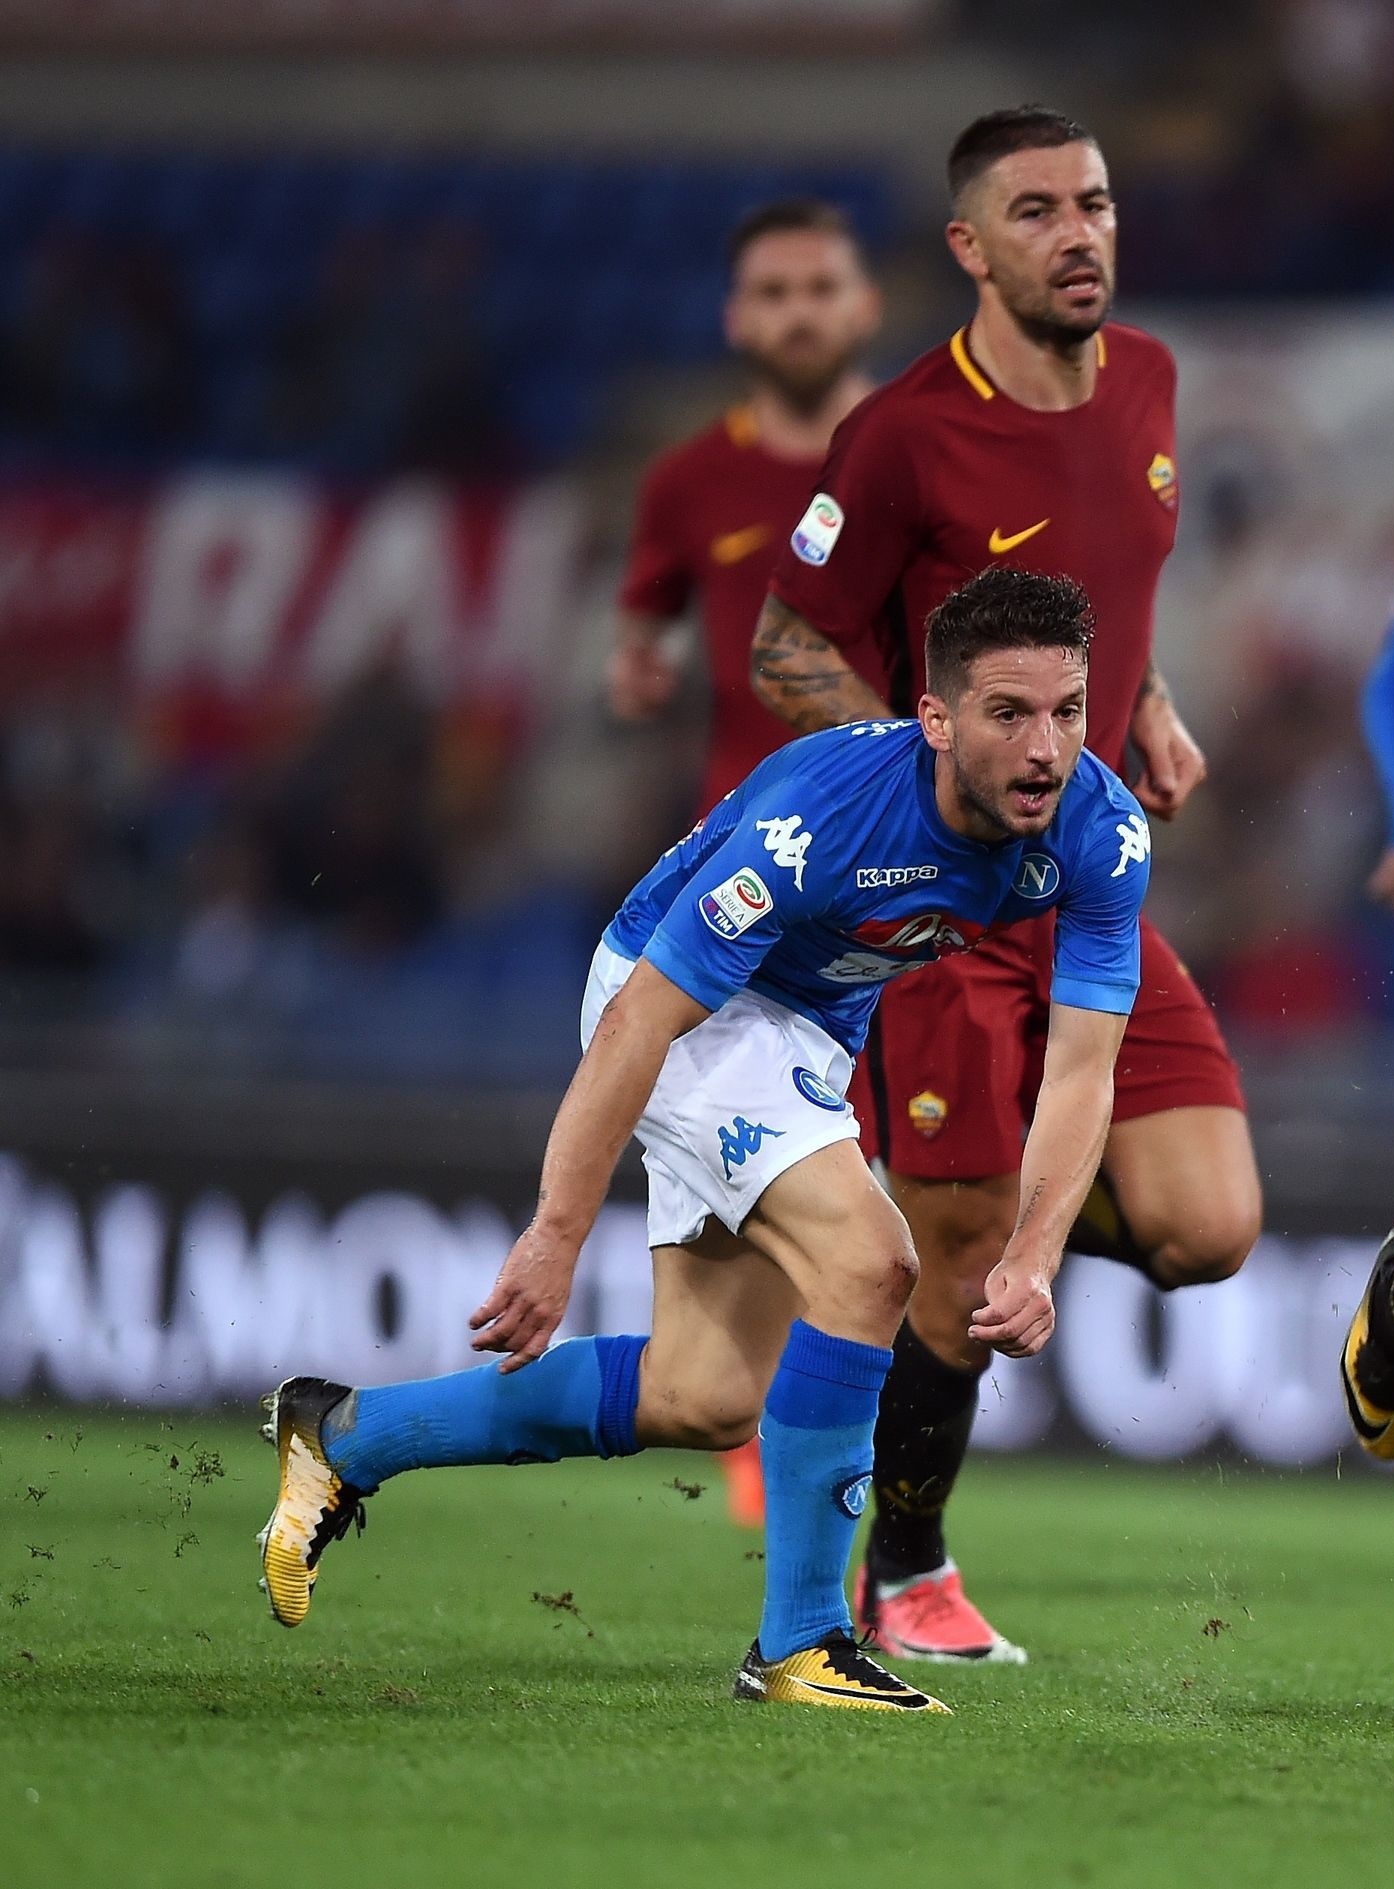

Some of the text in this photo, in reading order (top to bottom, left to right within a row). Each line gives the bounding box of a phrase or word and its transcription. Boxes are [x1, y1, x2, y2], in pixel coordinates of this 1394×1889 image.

[857, 865, 938, 888] Kappa
[1018, 861, 1052, 892] N
[718, 888, 738, 914] SERIE
[713, 909, 734, 933] TIM
